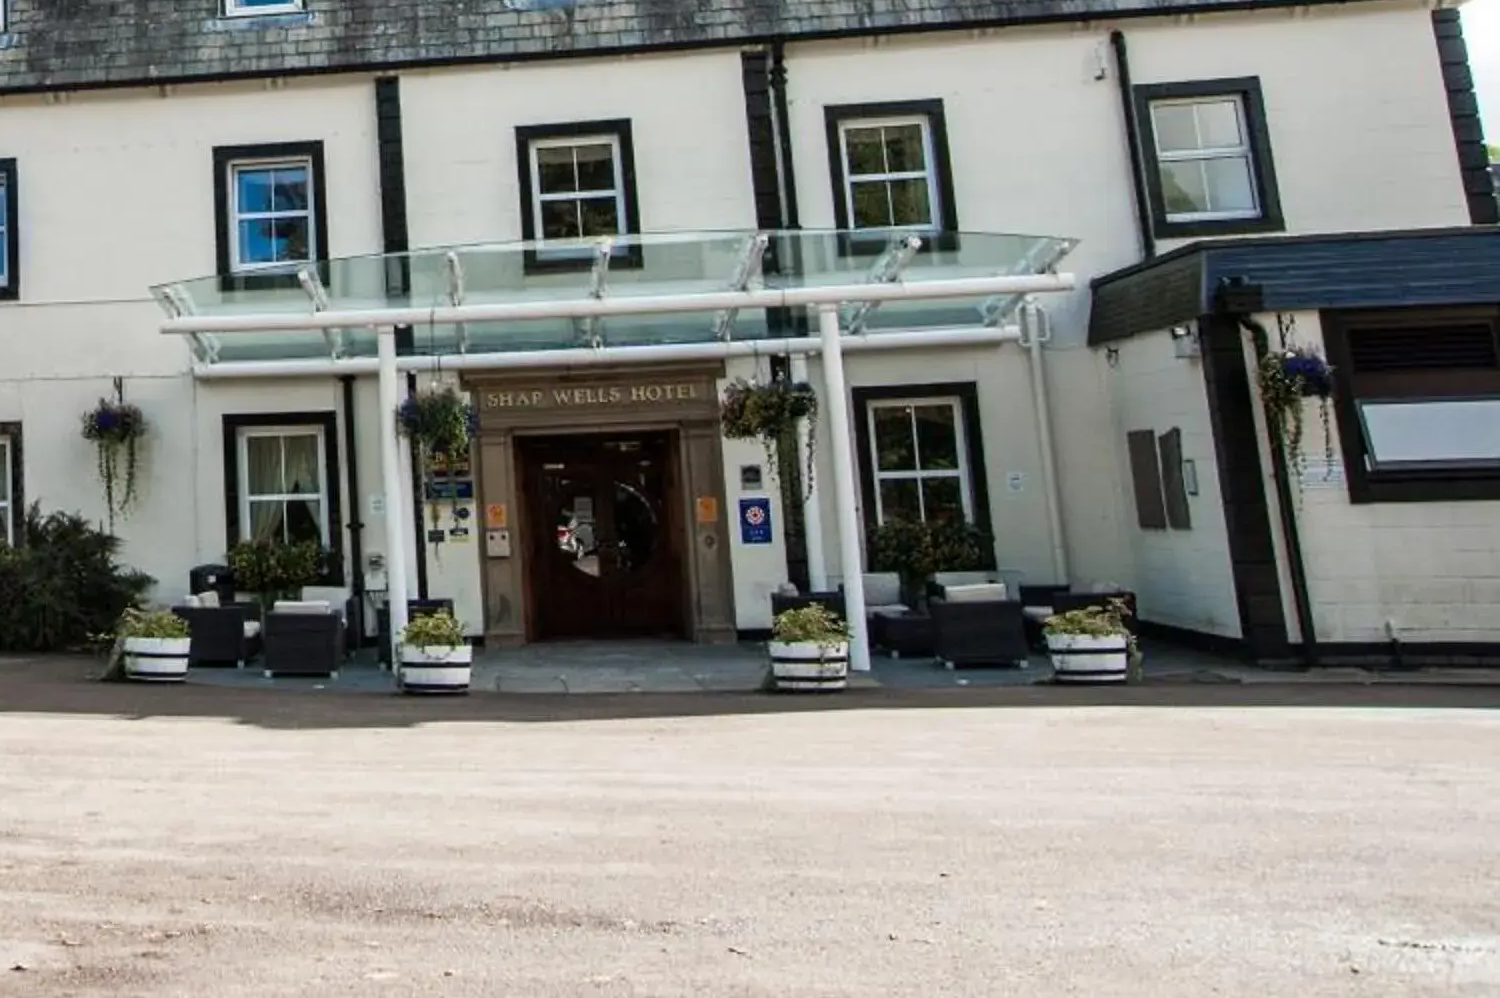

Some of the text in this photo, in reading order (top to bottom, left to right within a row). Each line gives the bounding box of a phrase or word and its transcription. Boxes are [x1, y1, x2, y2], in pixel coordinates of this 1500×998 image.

[487, 383, 697, 407] SHAP WELLS HOTEL
